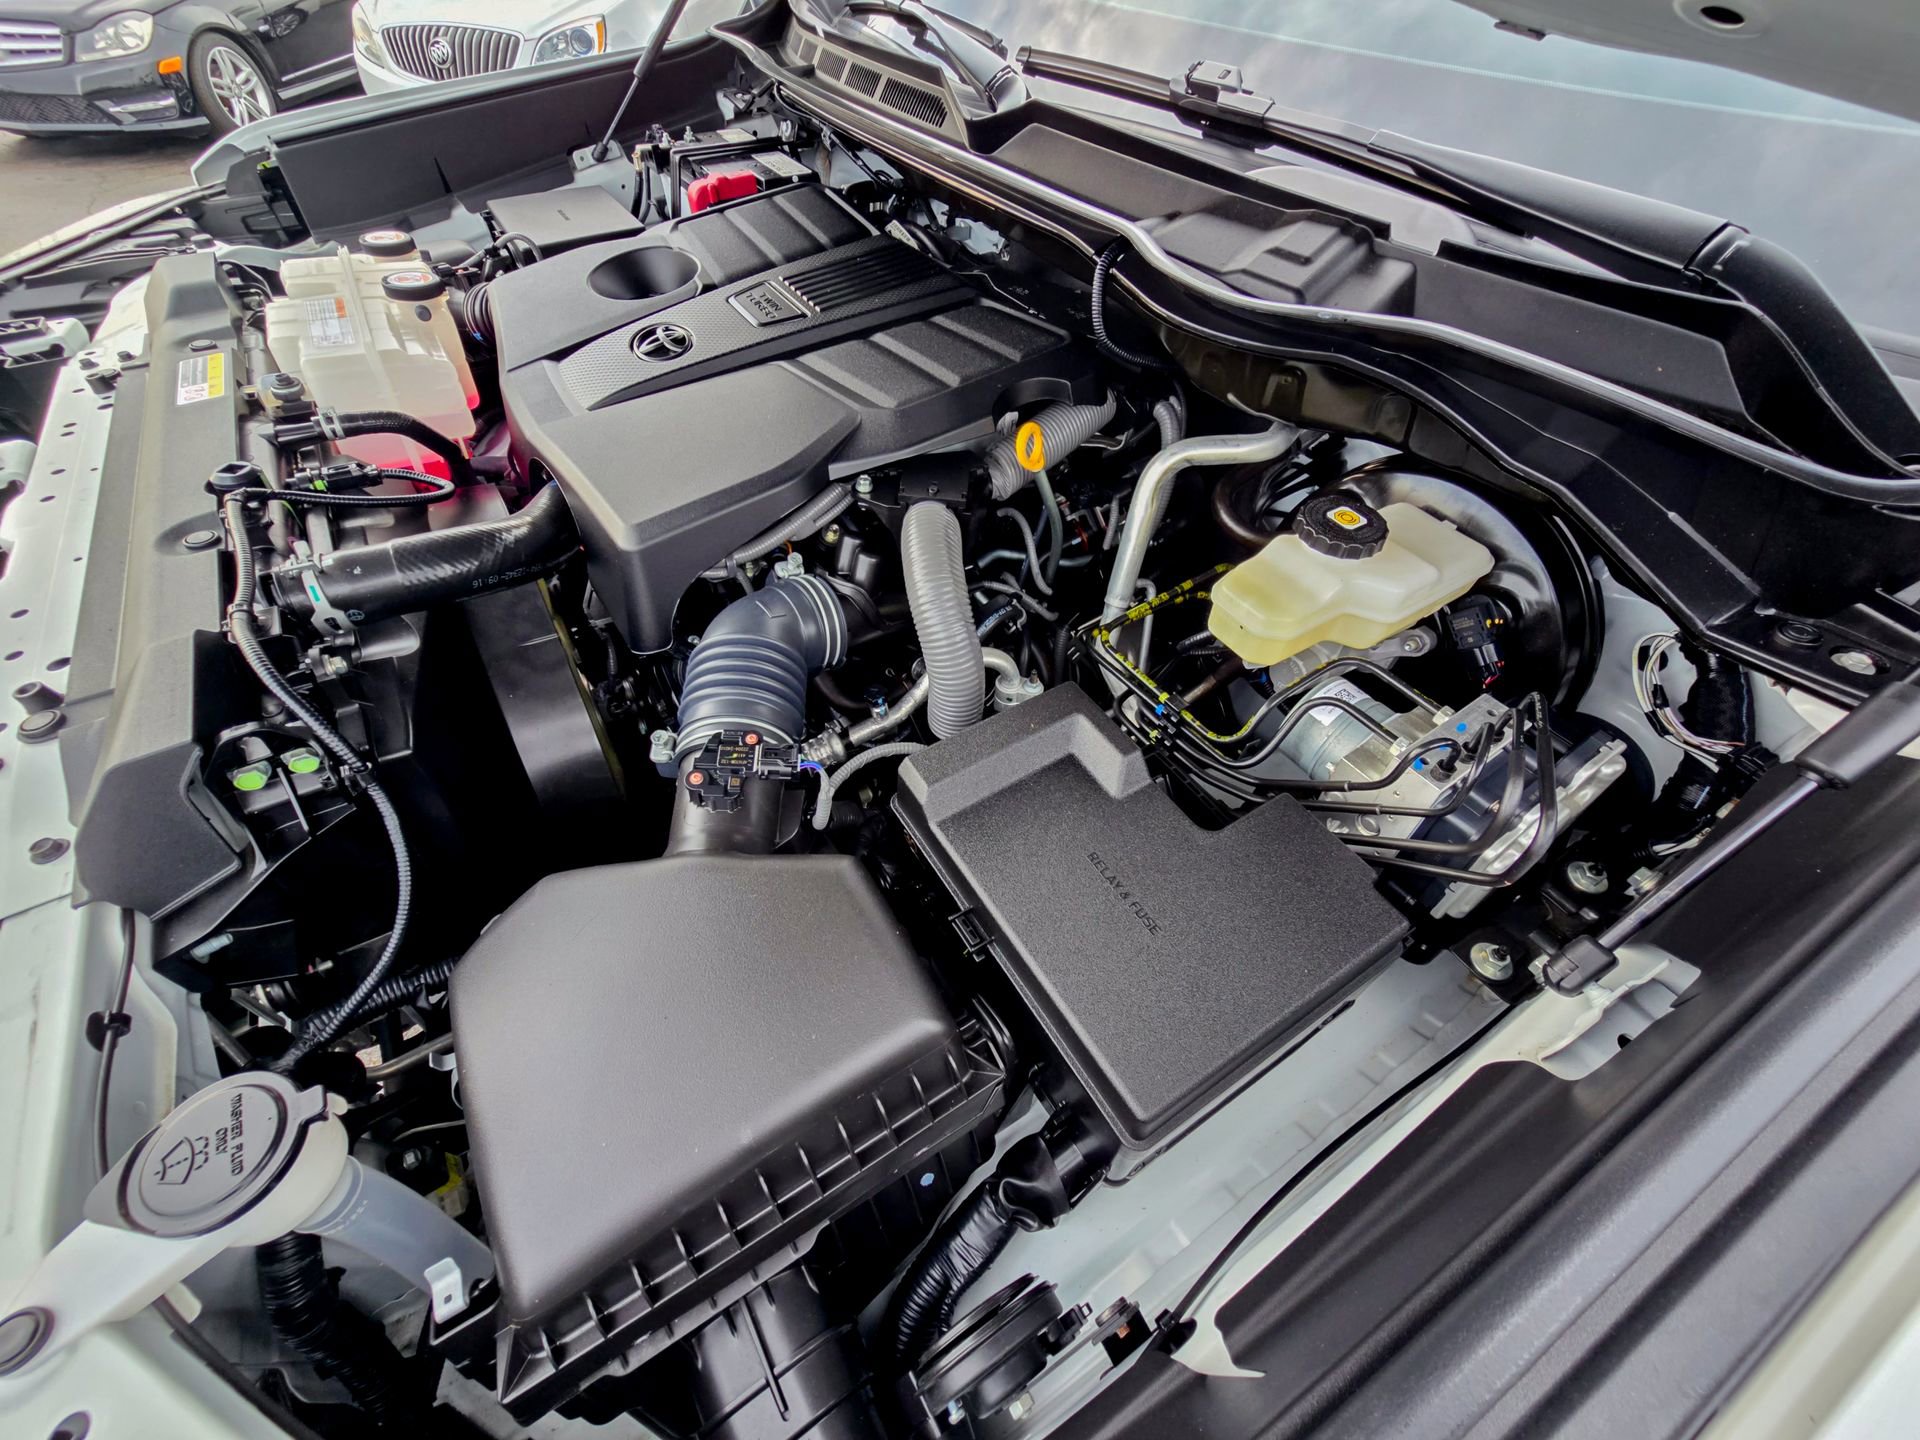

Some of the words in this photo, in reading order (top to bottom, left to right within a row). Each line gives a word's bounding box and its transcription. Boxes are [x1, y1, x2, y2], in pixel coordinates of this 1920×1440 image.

[746, 292, 778, 319] TURBO
[760, 292, 783, 312] TWIN
[1087, 851, 1124, 889] RELAY
[1119, 891, 1130, 900] &
[1128, 901, 1162, 936] FUSE
[230, 1093, 243, 1140] WASHER
[215, 1127, 228, 1155] ONLY
[230, 1143, 244, 1176] FLUID
